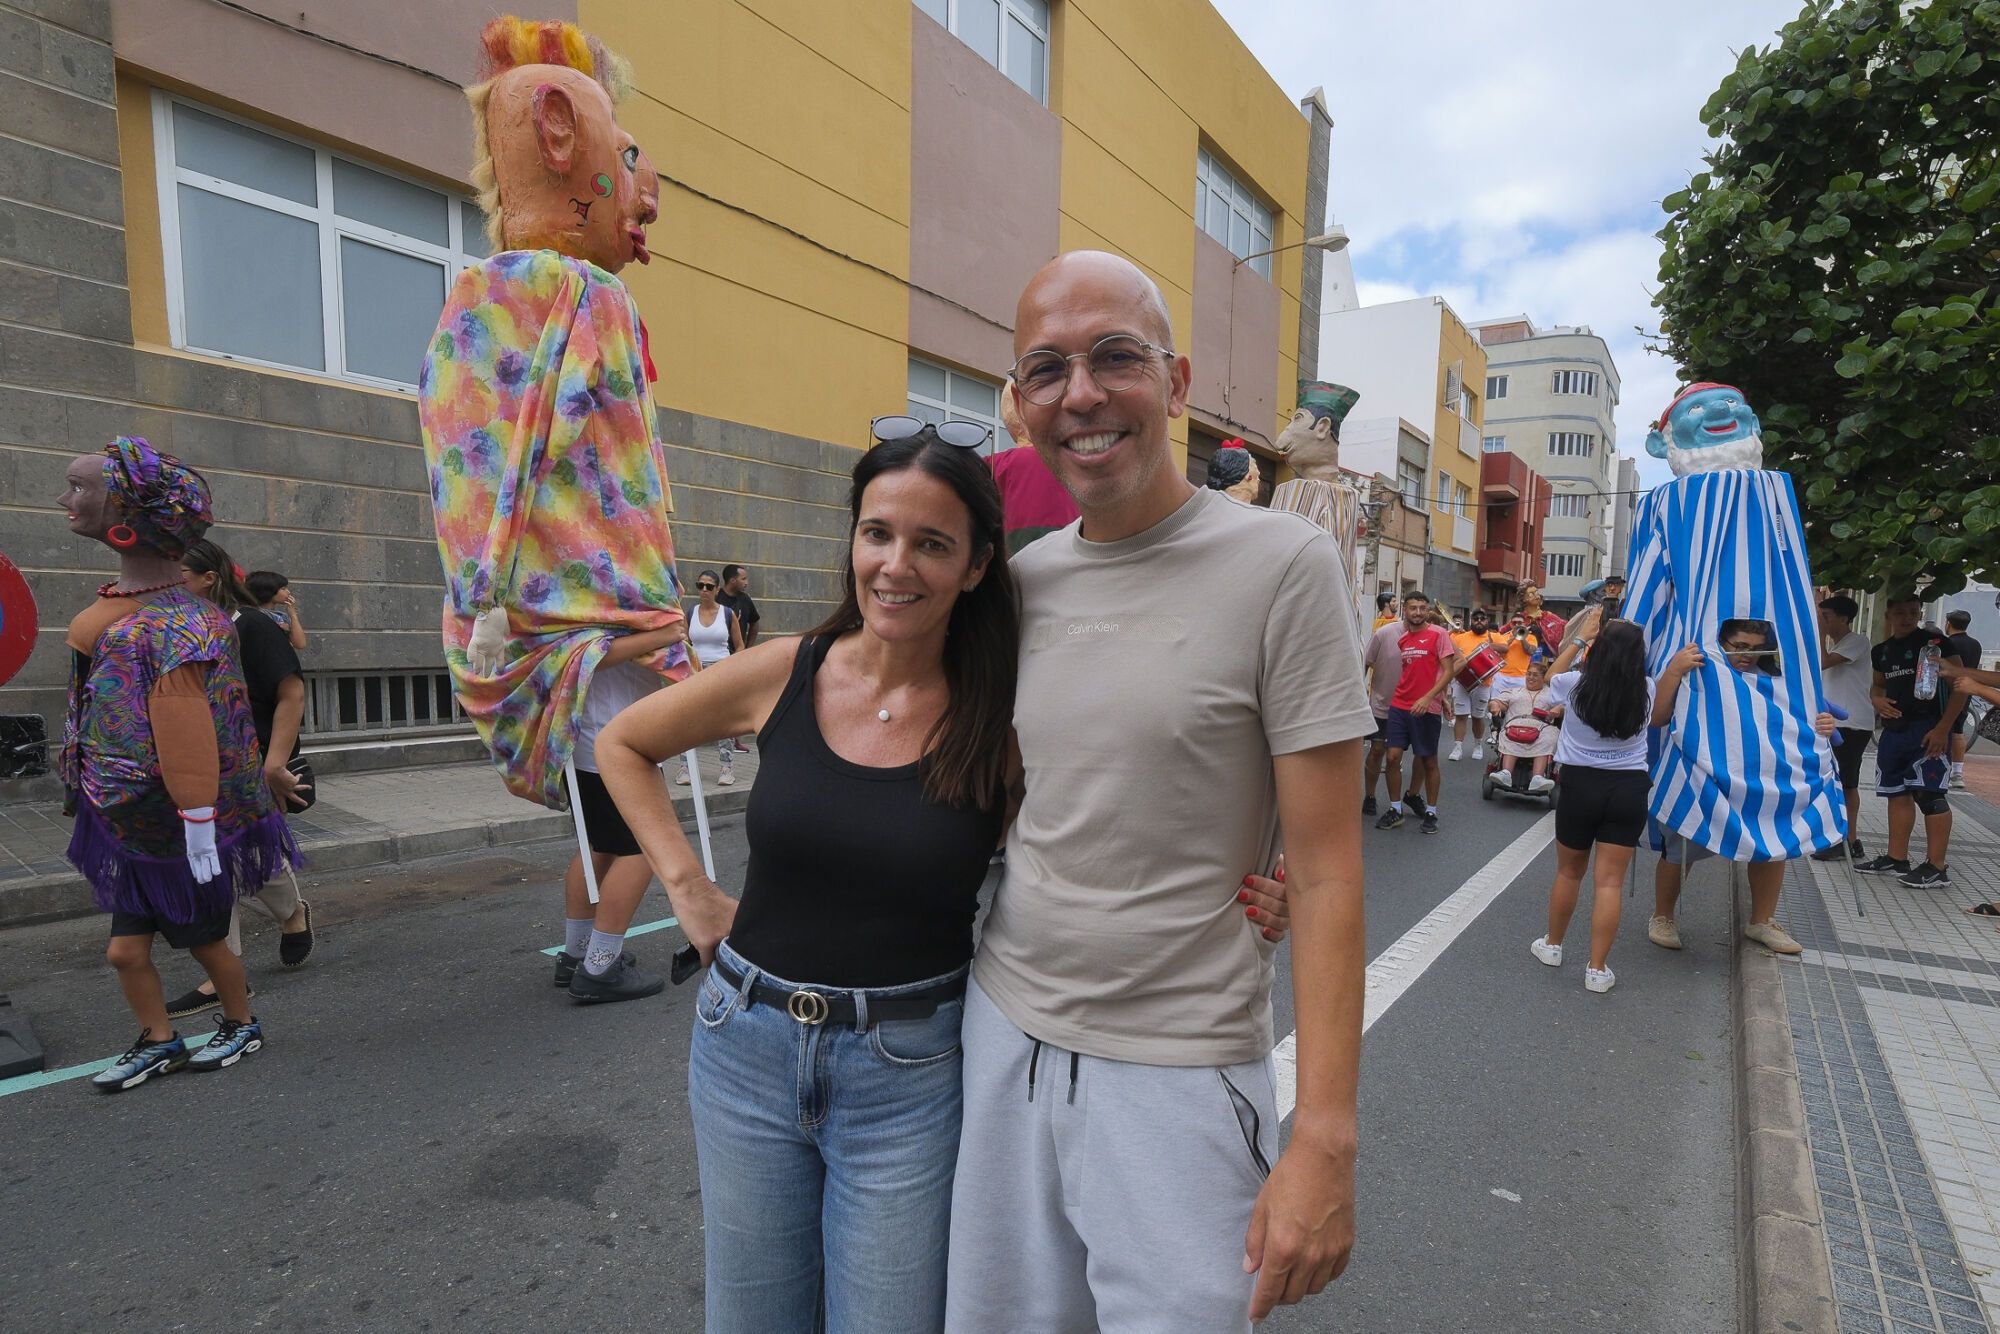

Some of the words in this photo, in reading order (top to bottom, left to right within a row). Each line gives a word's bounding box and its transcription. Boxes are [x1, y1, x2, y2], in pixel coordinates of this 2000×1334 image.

[1067, 623, 1093, 635] Calvin
[1094, 621, 1119, 632] Klein
[1884, 668, 1915, 680] Emirates
